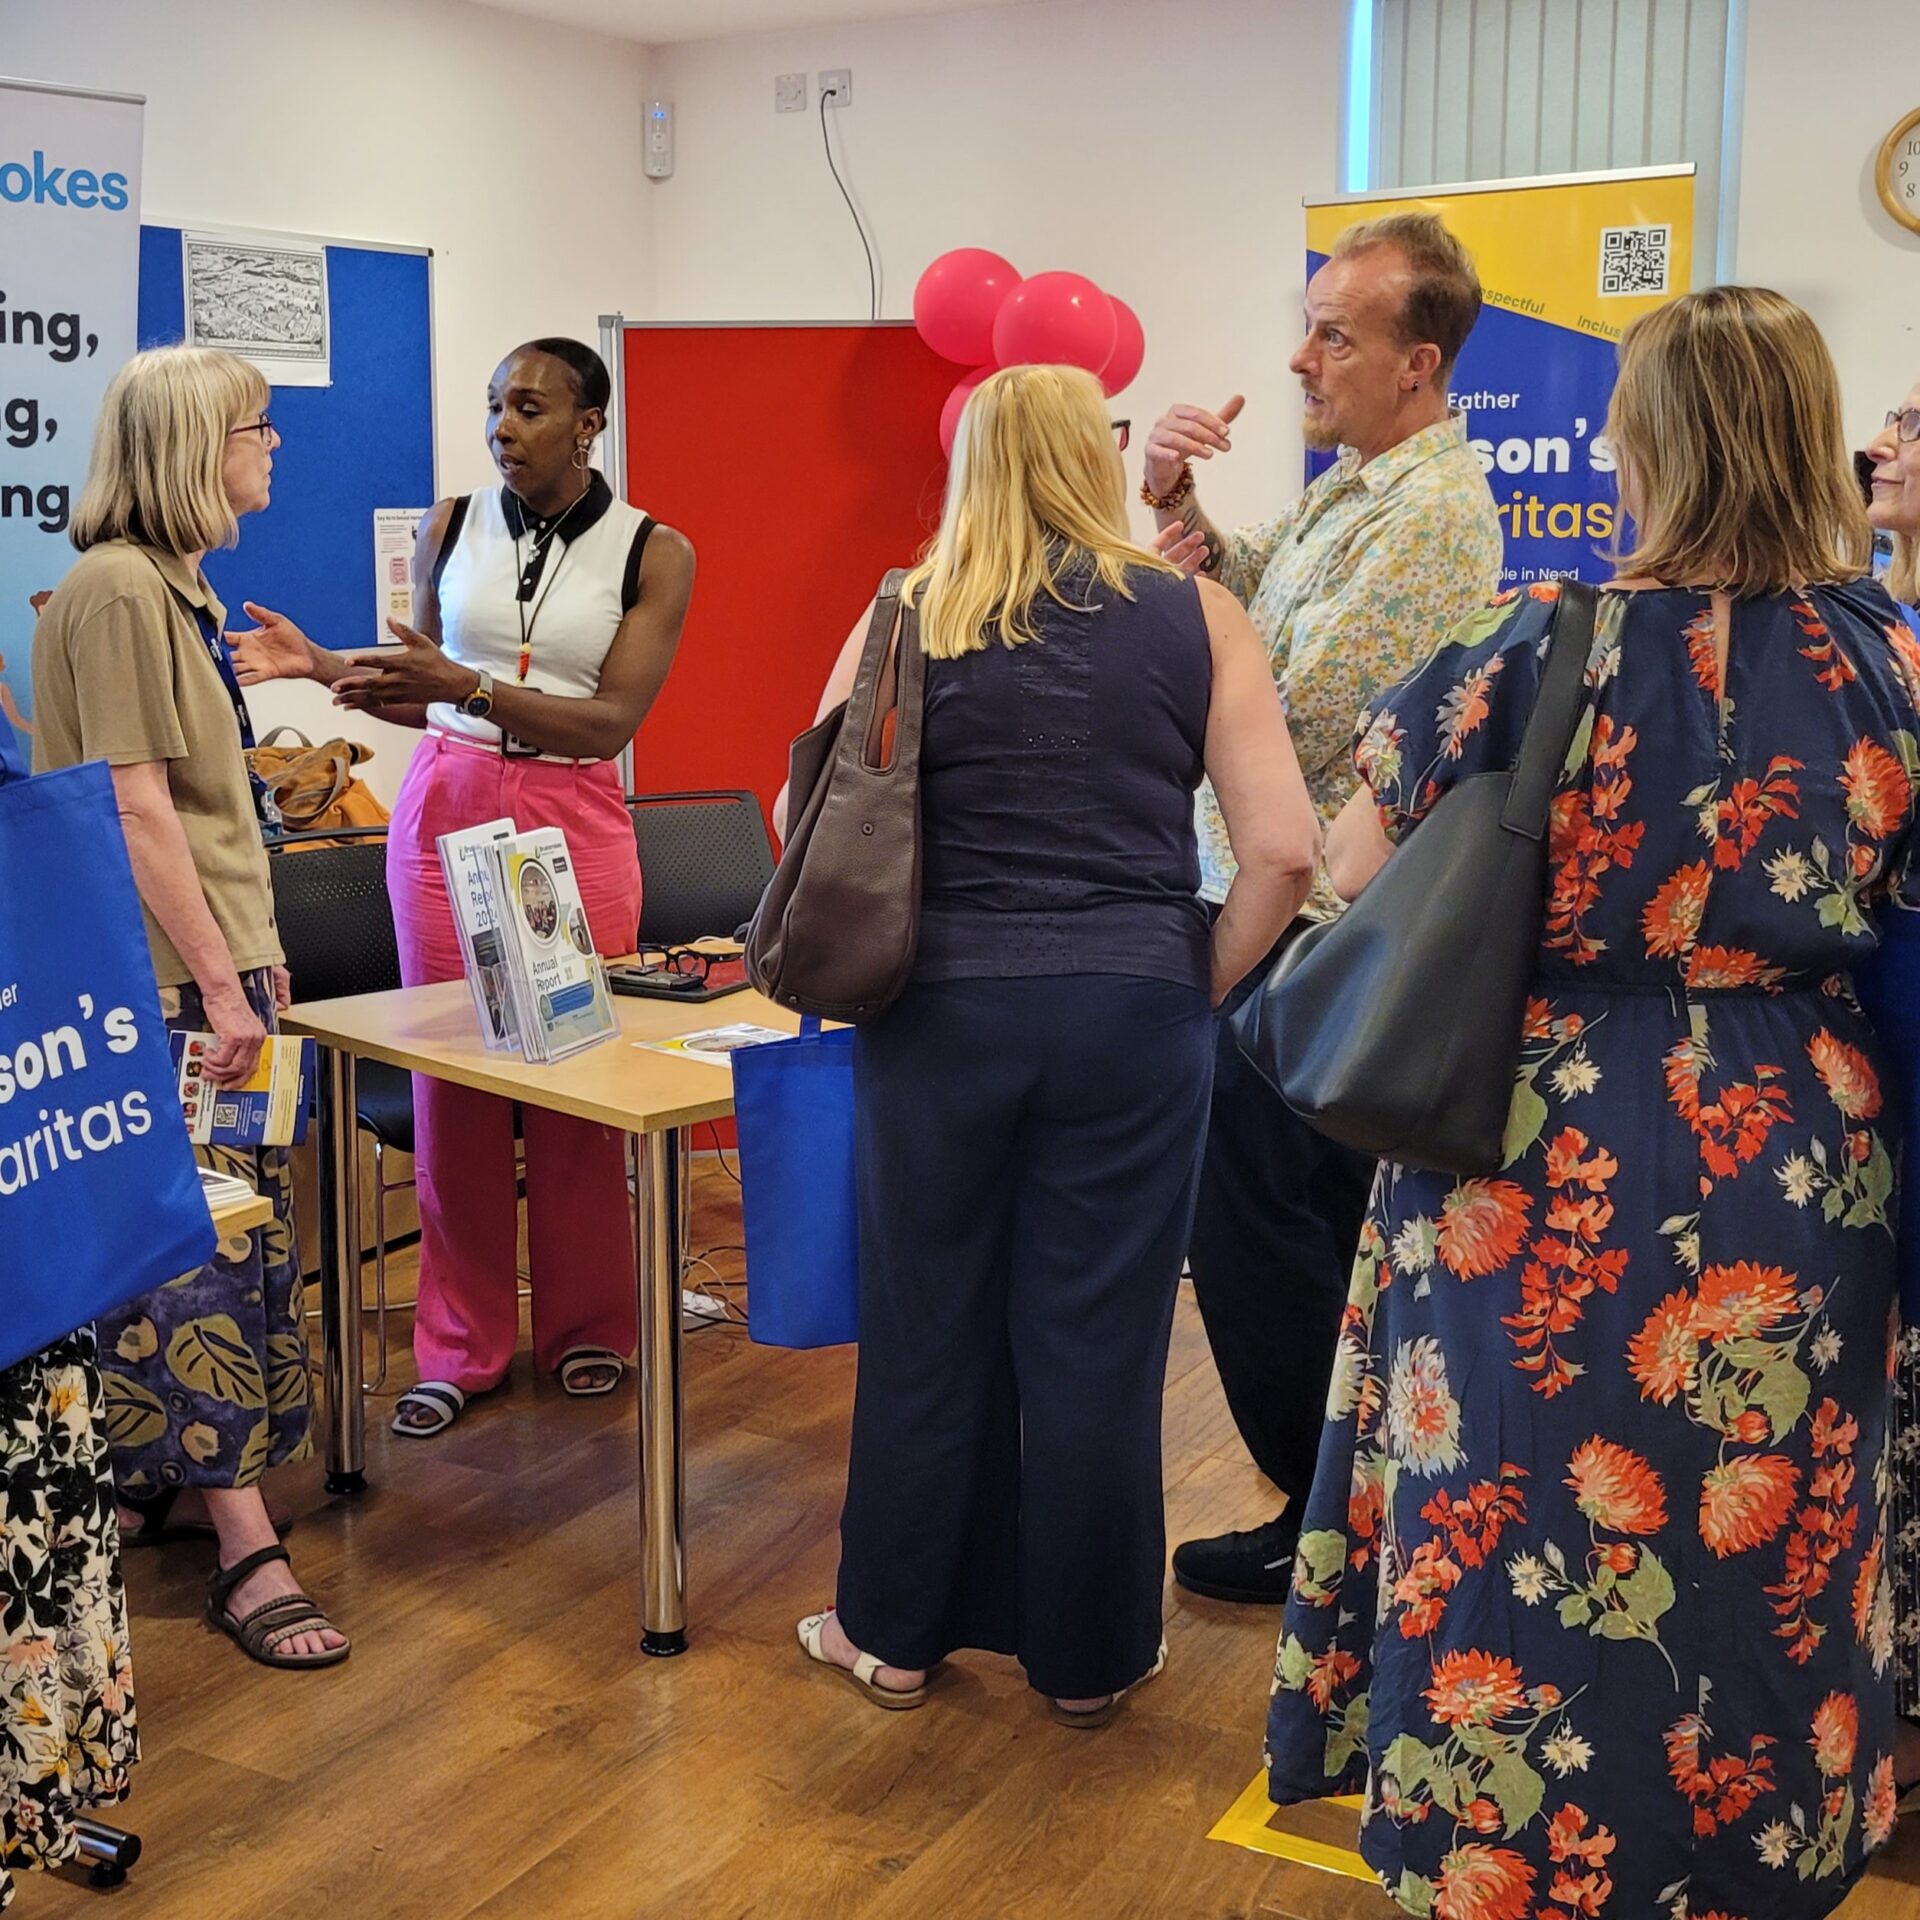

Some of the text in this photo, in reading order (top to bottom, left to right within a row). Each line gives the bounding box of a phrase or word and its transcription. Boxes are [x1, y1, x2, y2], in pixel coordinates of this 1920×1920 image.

[1898, 161, 1909, 177] 9
[1905, 182, 1916, 198] 8
[1447, 391, 1520, 409] Father
[1521, 567, 1534, 581] in
[532, 955, 558, 976] Annual
[0, 982, 18, 1011] er
[0, 1090, 152, 1195] aritas
